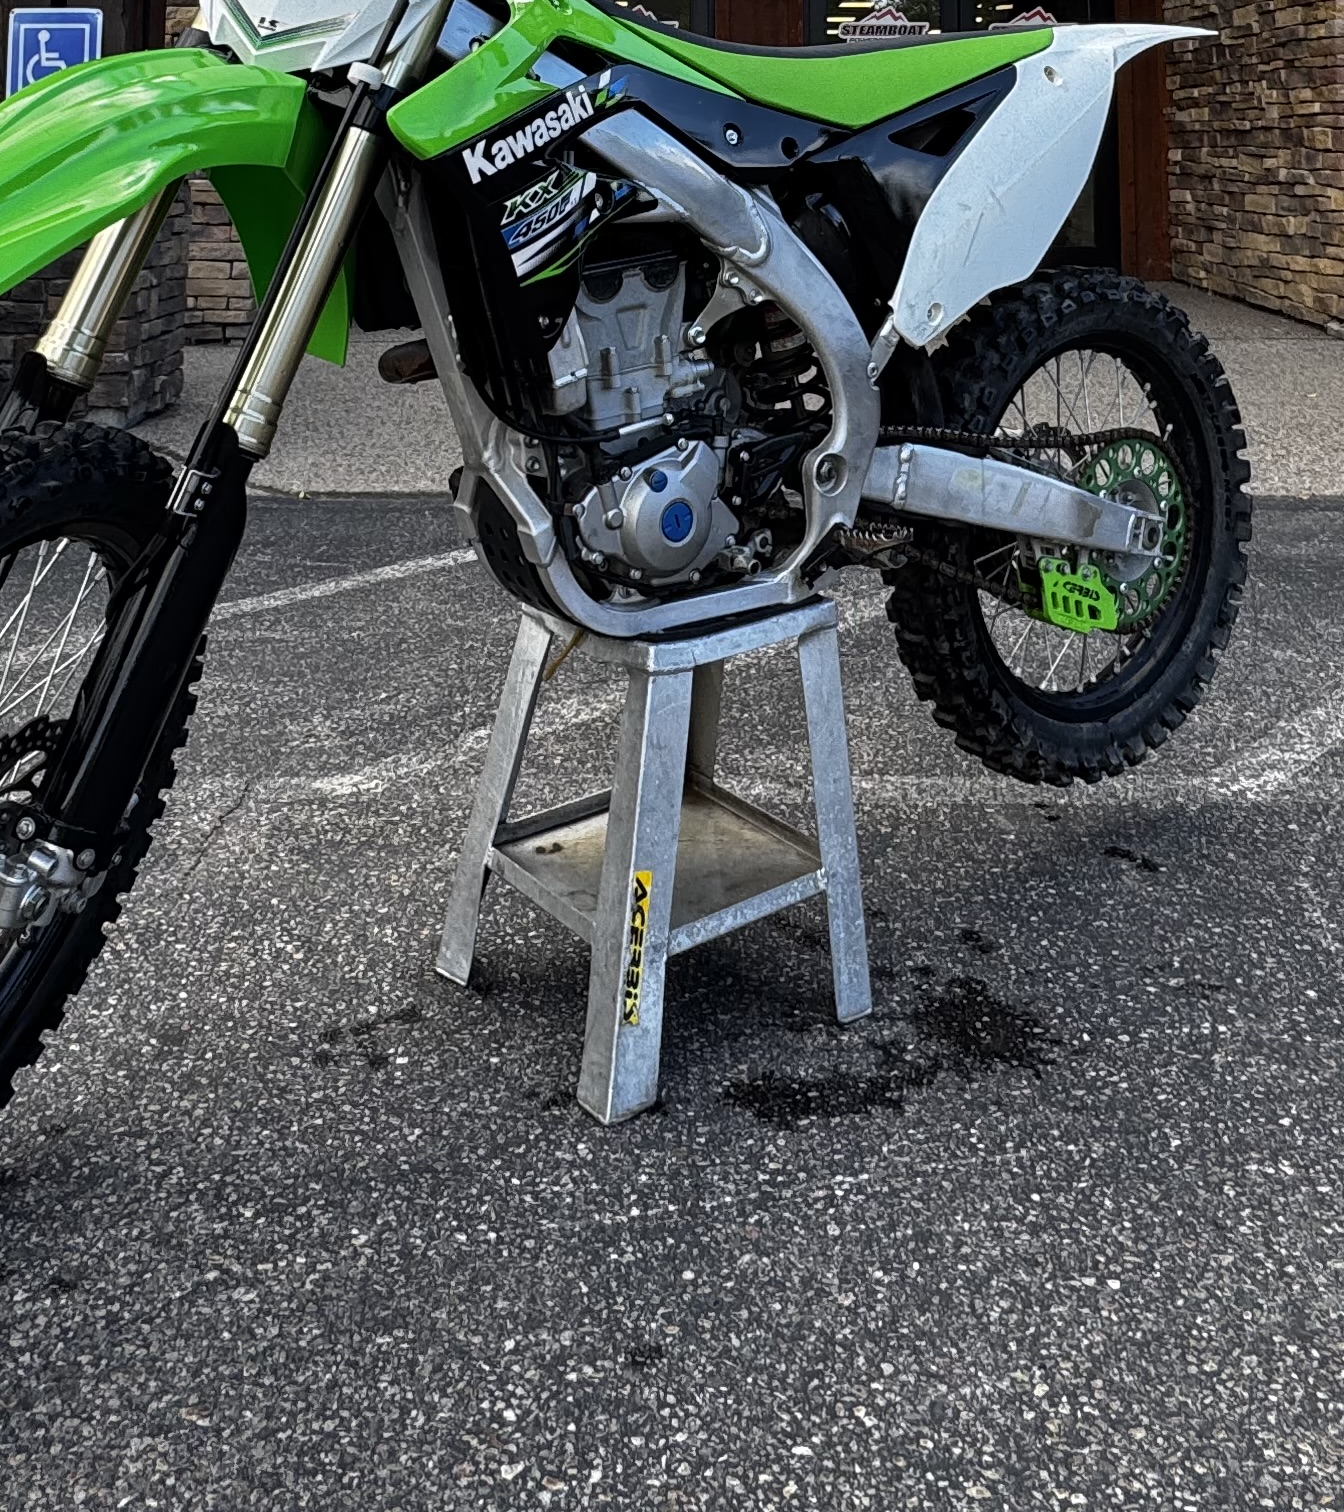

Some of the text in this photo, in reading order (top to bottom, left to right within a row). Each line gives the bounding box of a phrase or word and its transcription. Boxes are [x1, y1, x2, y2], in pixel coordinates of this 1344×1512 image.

[840, 24, 927, 36] STEAMBOAT
[461, 84, 595, 185] Kawasaki
[500, 169, 560, 226] KX
